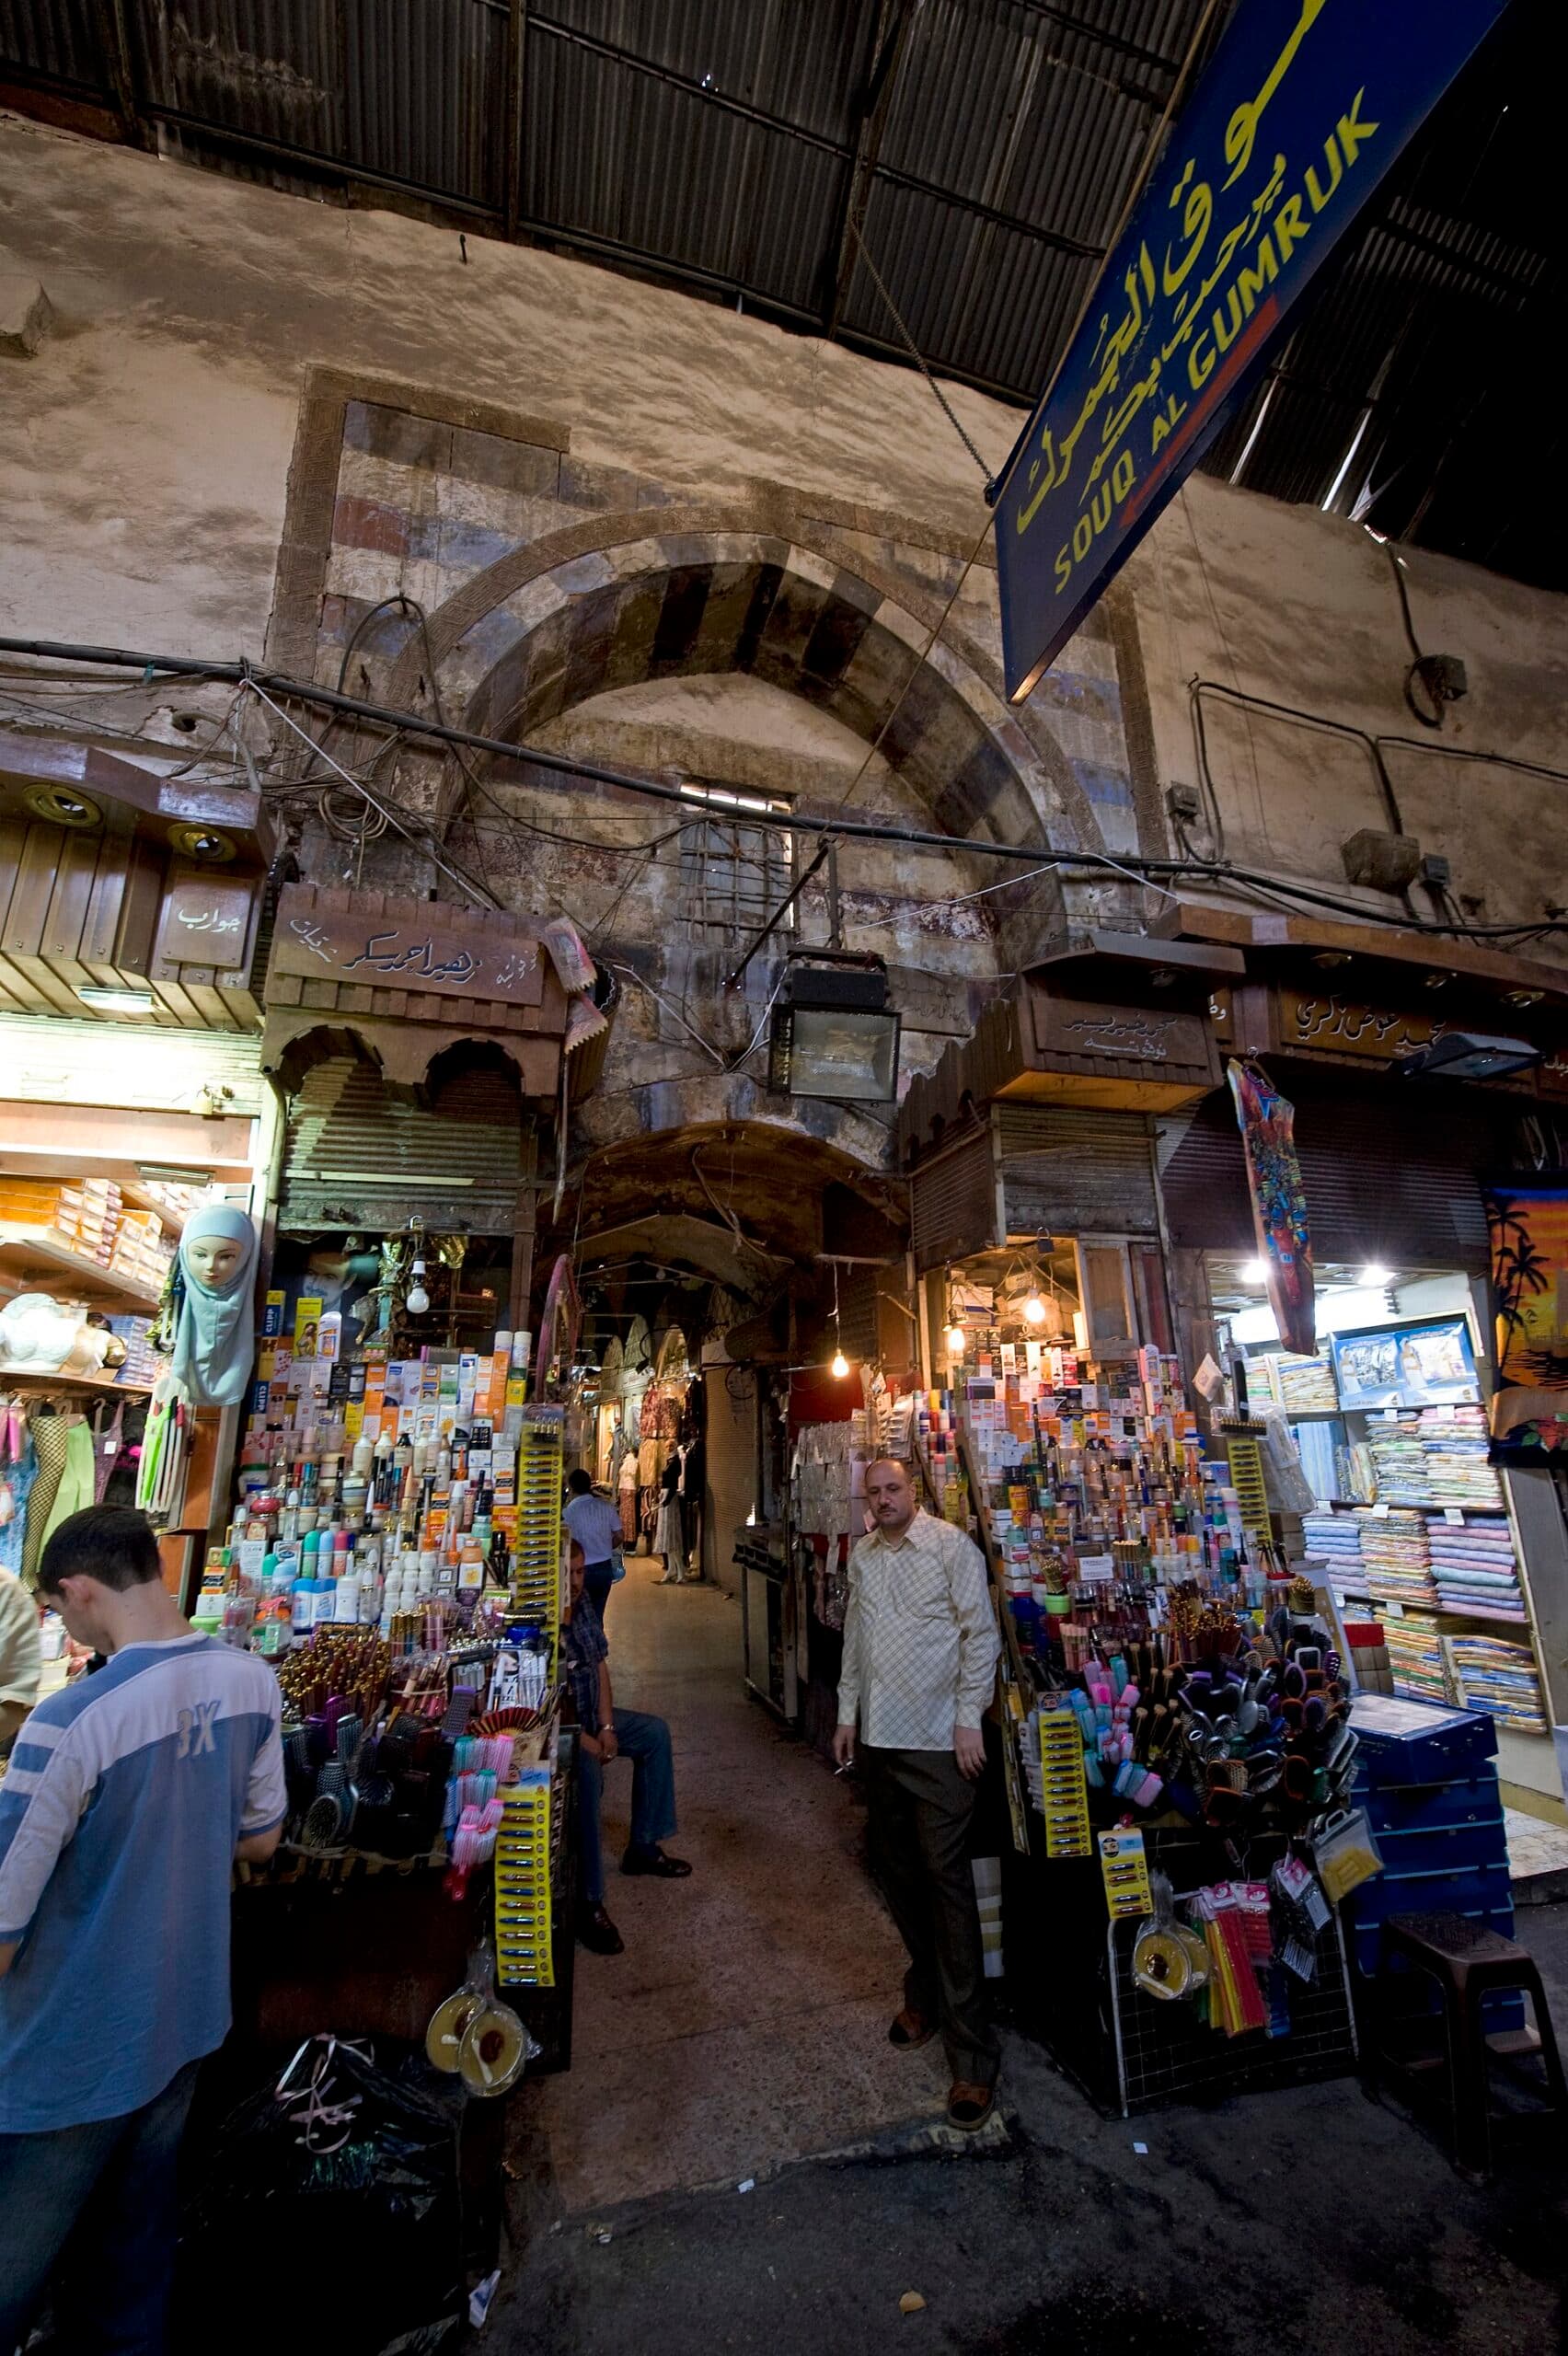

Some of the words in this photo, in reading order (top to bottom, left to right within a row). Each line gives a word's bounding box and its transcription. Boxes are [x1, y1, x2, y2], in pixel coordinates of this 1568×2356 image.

[1055, 453, 1136, 595] SOUQ
[1151, 397, 1188, 456] AL
[1188, 86, 1380, 390] GUMRUK
[1079, 356, 1162, 505] بكم
[178, 907, 241, 933] جوارب
